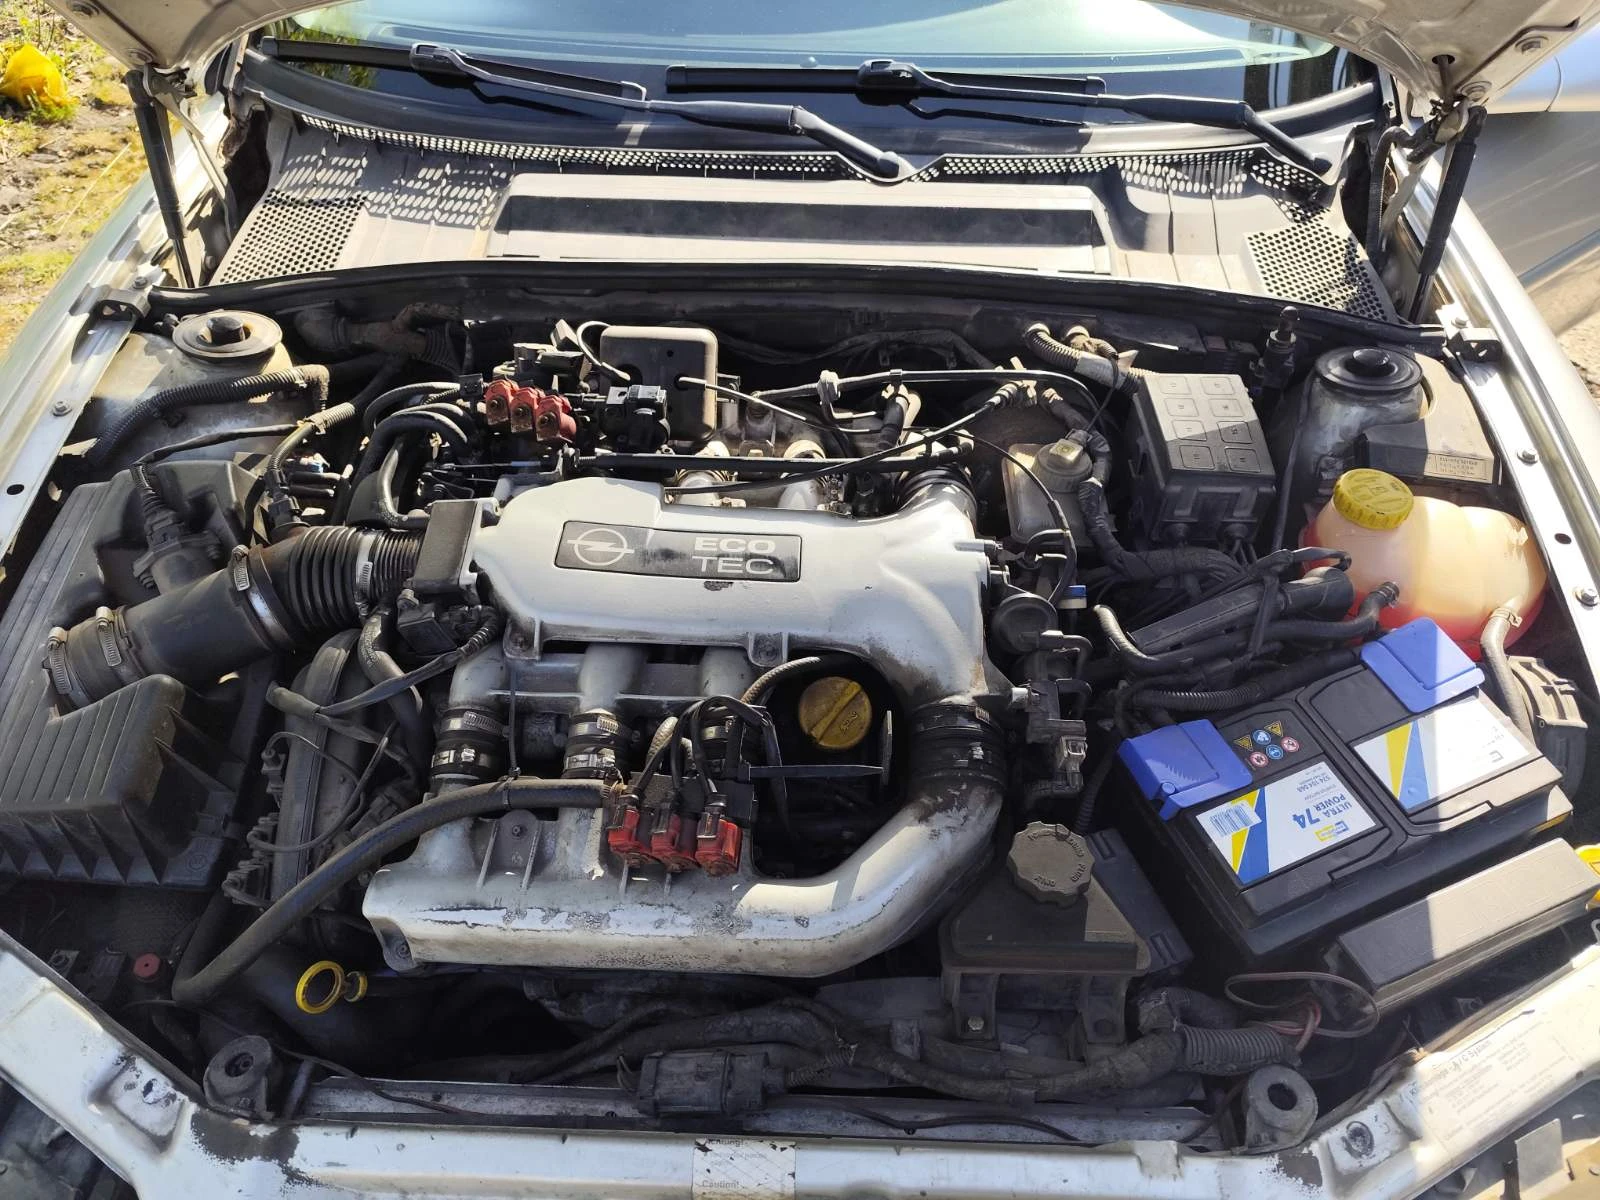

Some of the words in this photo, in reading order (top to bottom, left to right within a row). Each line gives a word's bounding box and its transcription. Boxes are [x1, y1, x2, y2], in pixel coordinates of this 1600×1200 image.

[695, 537, 776, 554] ECO
[692, 555, 773, 575] TEC
[1314, 794, 1346, 811] POWER
[1323, 802, 1352, 817] ULTRA
[1293, 808, 1320, 828] 74
[702, 1179, 739, 1188] Caution!
